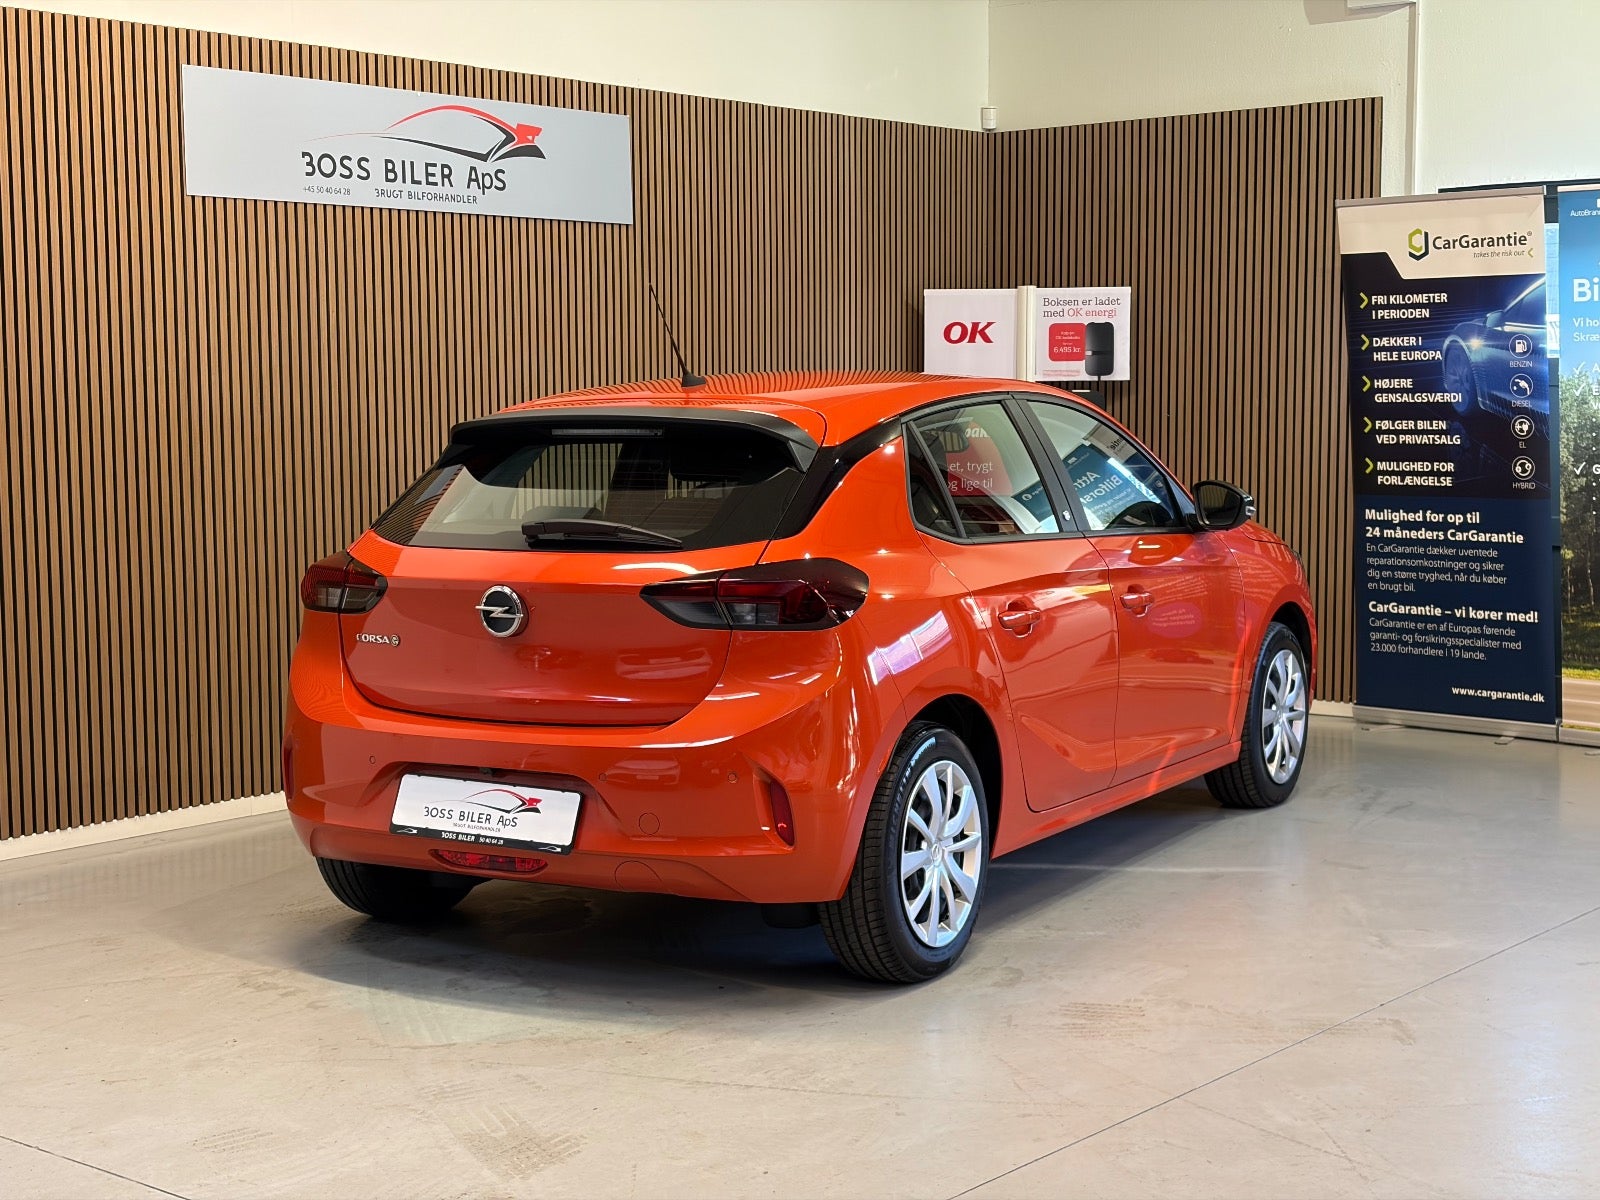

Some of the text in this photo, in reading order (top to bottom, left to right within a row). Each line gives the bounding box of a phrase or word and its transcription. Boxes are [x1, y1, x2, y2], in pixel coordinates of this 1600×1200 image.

[384, 158, 454, 188] BILER
[466, 165, 507, 196] ApS
[302, 185, 351, 196] +45 50 40 64 28
[407, 190, 478, 204] BILFORHANDLER
[1043, 296, 1121, 307] Boksen er ladet
[1371, 293, 1448, 305] FRI KILOMETER
[1043, 308, 1117, 318] med OK energi
[1372, 309, 1430, 319] I PERIODEN
[1573, 317, 1584, 328] Vi
[943, 321, 996, 345] OK
[1373, 337, 1422, 347] DÆKKER I
[1373, 351, 1443, 361] HELE EUROPA
[1374, 379, 1413, 389] HØJERE
[1374, 393, 1462, 403] GENSALGSVÆRDI
[1511, 400, 1532, 408] DIESEL
[1375, 420, 1447, 430] FØLGER BILEN
[1376, 434, 1461, 445] VED PRIVATSALG
[1519, 441, 1526, 449] EL
[967, 461, 993, 474] trygt
[1376, 461, 1455, 472] MULIGHED FOR
[961, 478, 980, 492] lige
[983, 478, 993, 489] til
[1377, 475, 1453, 487] FORLÆNGELSE
[1512, 482, 1536, 490] HYBRID
[1365, 509, 1480, 526] Mulighed for op til
[1365, 526, 1524, 543] 24 måneders CarGarantie
[1366, 543, 1498, 558] En CarGarantie dækker uventede
[1367, 557, 1504, 572] reparationsomkostninger og sikrer
[1367, 569, 1507, 584] dig en større tryghed, når du køber
[1367, 581, 1416, 593] en brugt bil.
[1369, 601, 1442, 616] CarGarantie
[1454, 606, 1466, 618] vi
[1469, 606, 1503, 620] kører
[1506, 610, 1539, 623] med!
[1369, 617, 1416, 630] CarGarantie
[1439, 622, 1447, 631] af
[1448, 623, 1481, 635] Europas
[1483, 625, 1516, 636] førende
[1370, 631, 1522, 650] garanti- og forsikringsspecialister med
[1371, 643, 1397, 653] 23.000
[1398, 644, 1443, 657] forhandlere
[1451, 649, 1460, 658] 19
[1462, 649, 1487, 660] lande.
[1452, 687, 1545, 703] www.cargarantie.dk
[458, 811, 492, 825] BILER
[497, 815, 518, 829] ApS
[458, 833, 475, 842] BILER
